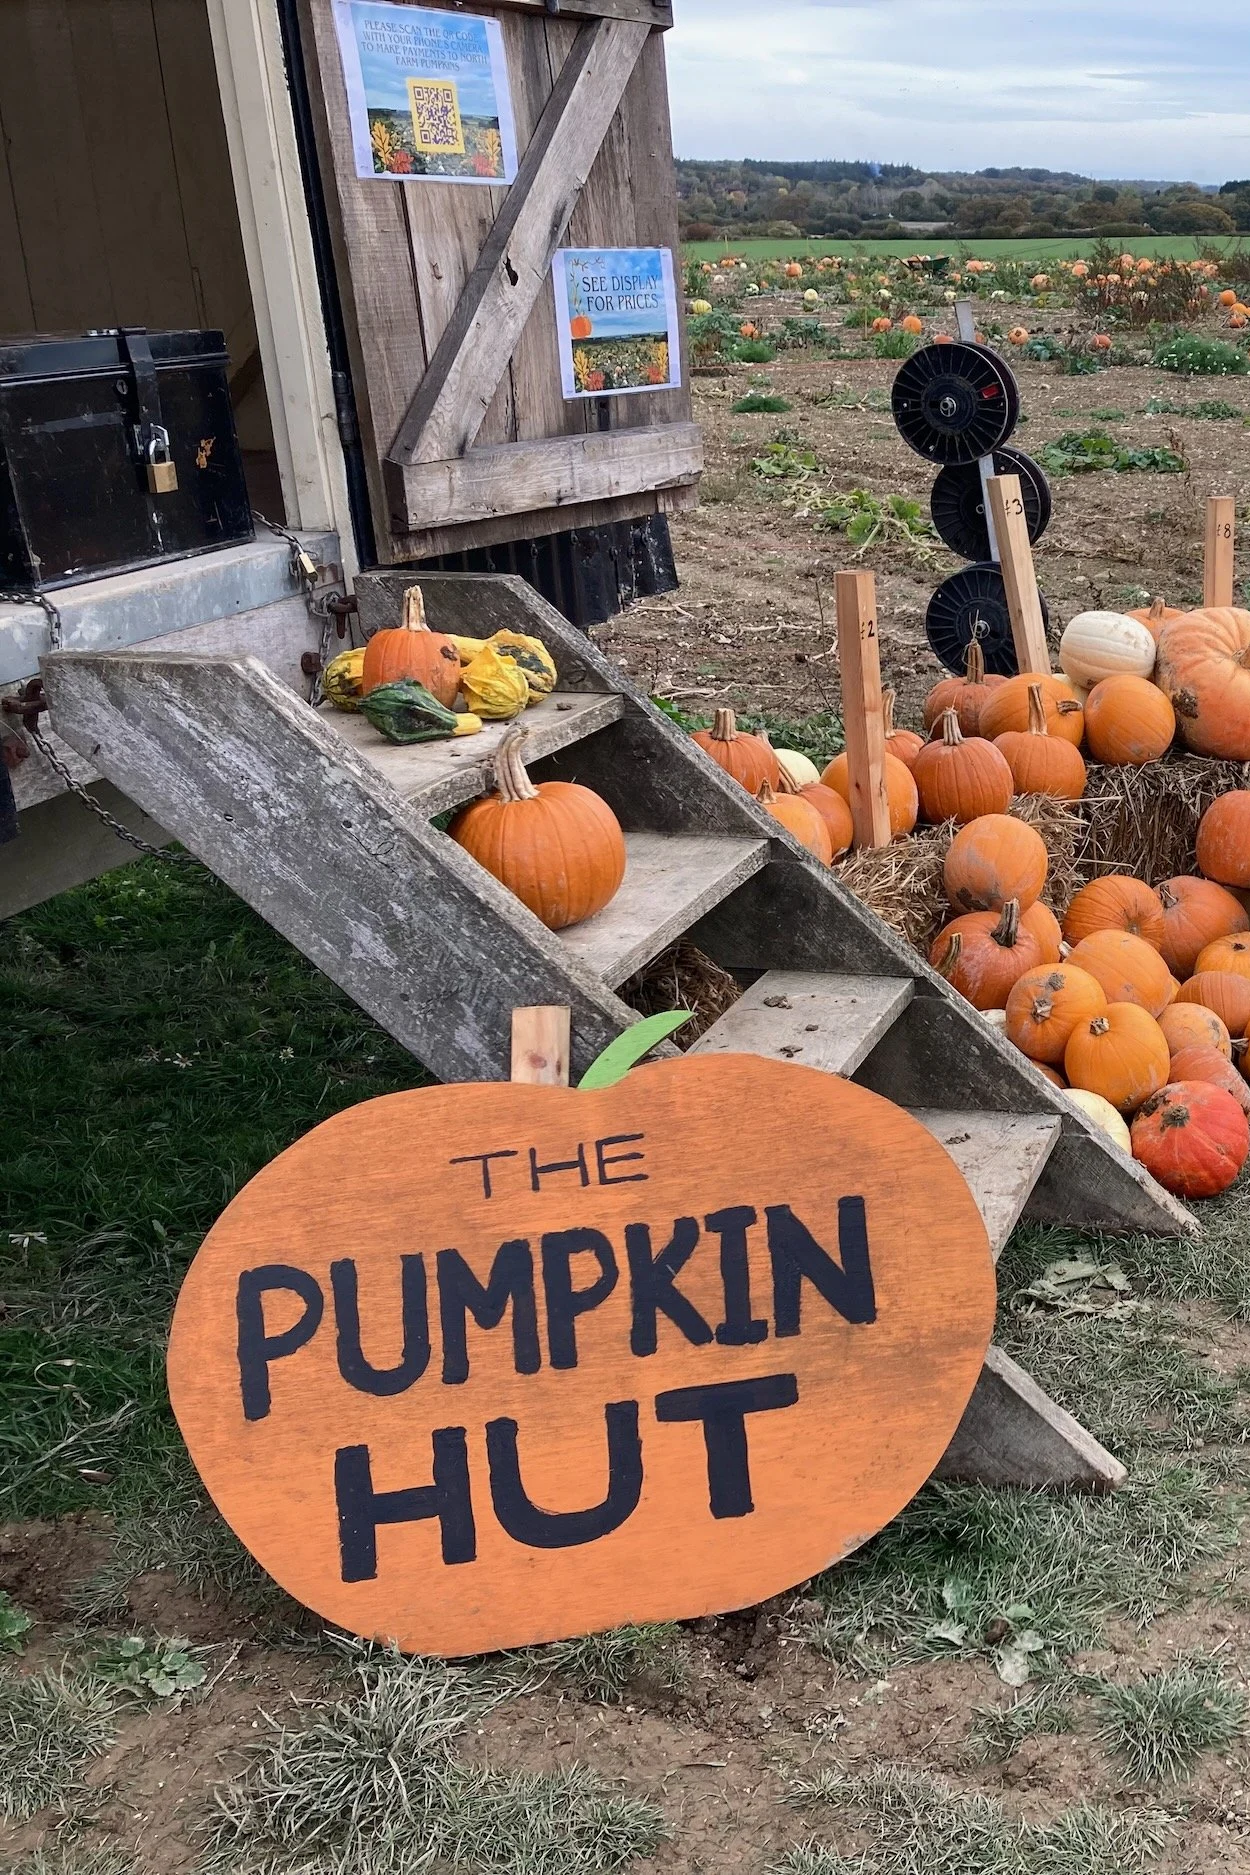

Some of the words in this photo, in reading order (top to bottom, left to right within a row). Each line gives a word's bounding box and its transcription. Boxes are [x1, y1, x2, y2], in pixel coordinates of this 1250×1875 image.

[364, 20, 397, 33] PLEASE
[398, 24, 422, 36] SCAN
[423, 27, 441, 38] THE
[442, 30, 455, 40] QR
[362, 31, 386, 42] WITH
[388, 33, 412, 45] YOUR
[450, 41, 485, 53] CAMERA
[361, 41, 374, 51] TO
[376, 43, 401, 55] MAKE
[402, 45, 446, 60] PAYMENTS
[447, 50, 459, 61] TO
[460, 53, 488, 65] NORTH
[395, 56, 419, 68] FARM
[420, 58, 460, 71] PUMPKINS
[582, 276, 608, 292] SEE
[612, 275, 659, 291] DISPLAY
[587, 295, 614, 312] FOR
[618, 294, 659, 310] PRICES
[1004, 498, 1023, 518] £3
[449, 1132, 649, 1200] THE
[235, 1195, 878, 1421] PUMPKIN
[334, 1373, 799, 1584] HUT
